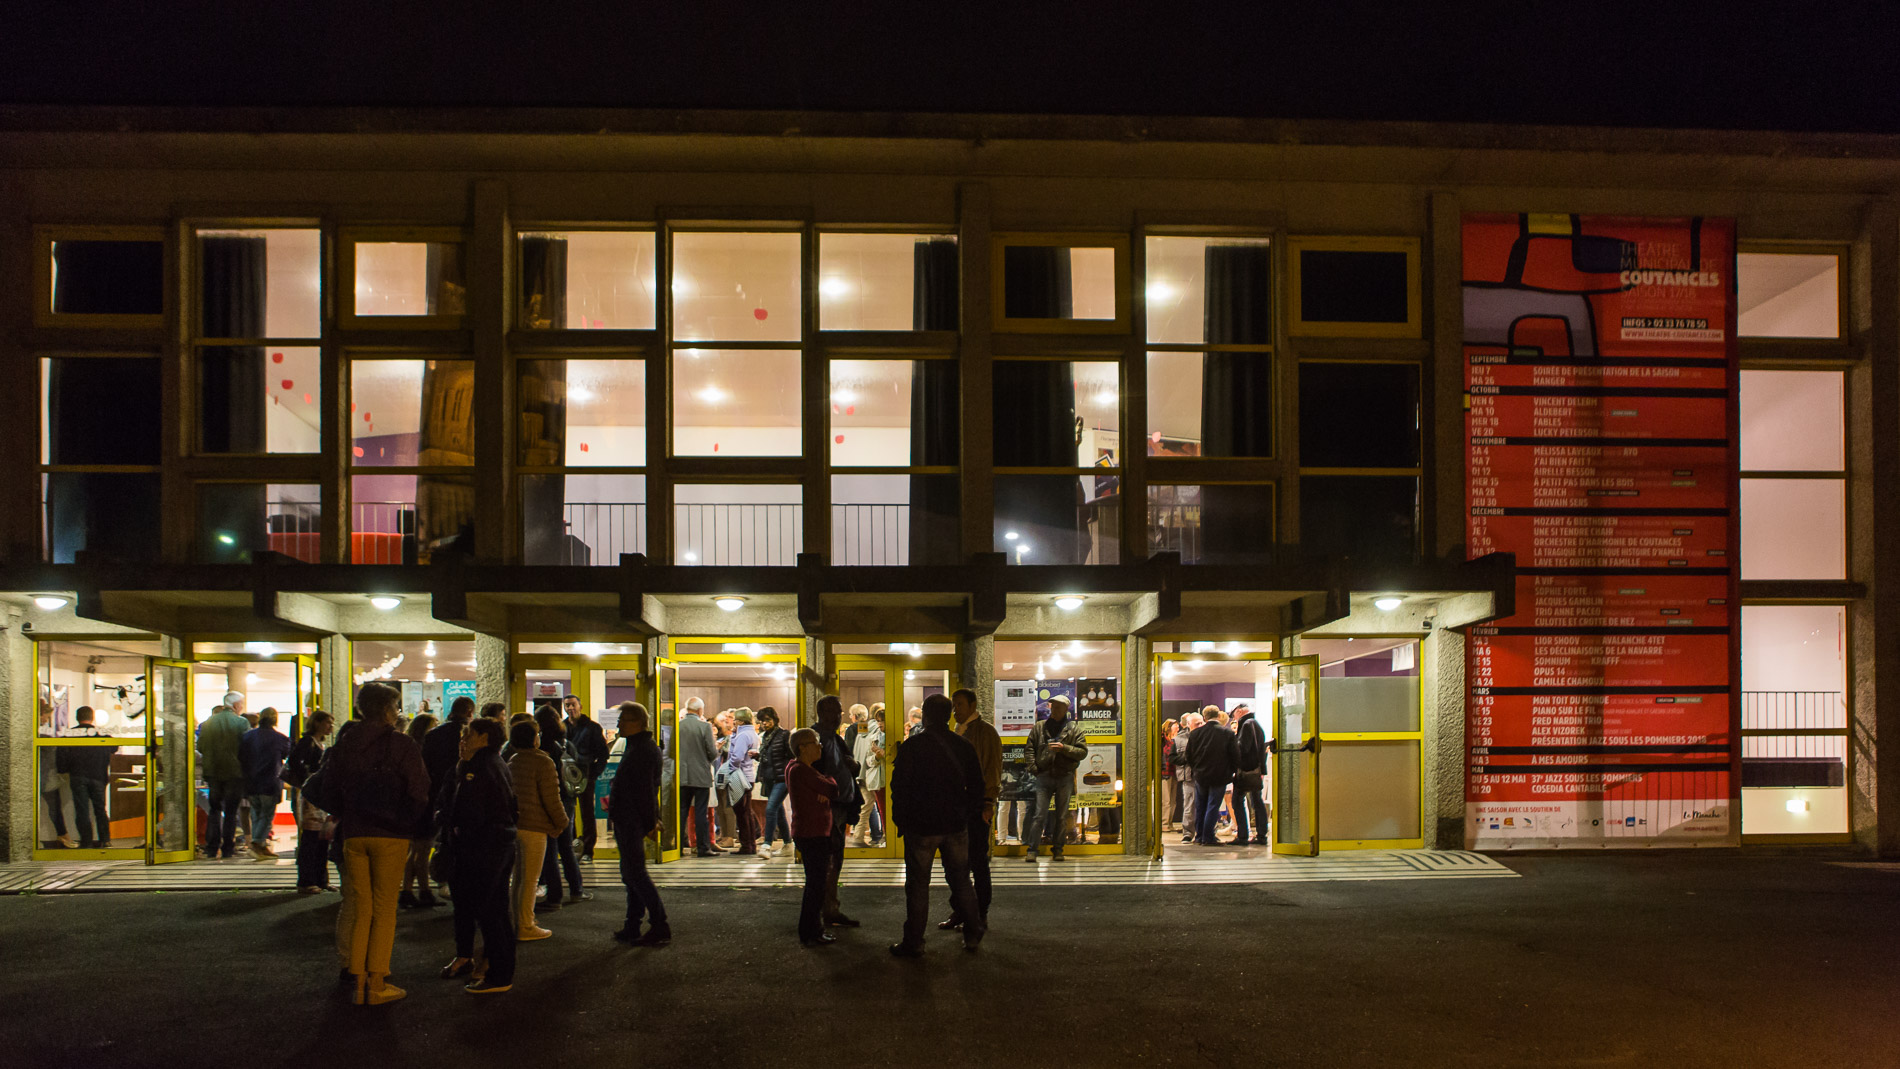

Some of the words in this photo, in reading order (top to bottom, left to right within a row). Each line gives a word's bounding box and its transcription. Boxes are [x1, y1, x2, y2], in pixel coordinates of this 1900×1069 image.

[1619, 269, 1720, 287] COUTANCES
[1623, 318, 1646, 327] INFOS
[1653, 318, 1664, 328] 02
[1665, 319, 1675, 328] 33
[1675, 319, 1685, 328] 76
[1470, 355, 1508, 364] SEPTEMBRE
[1471, 367, 1485, 376] JEU
[1561, 367, 1571, 377] DE
[1629, 368, 1639, 377] DE
[1640, 368, 1651, 377] LA
[1652, 368, 1680, 377] SAISON
[1471, 376, 1483, 385] MA
[1484, 376, 1495, 385] 26
[1533, 377, 1566, 386] MANGER
[1471, 386, 1501, 394] OCTOBRE
[1471, 397, 1487, 406] VEN
[1533, 397, 1566, 406] VINCENT
[1471, 407, 1484, 416] MA
[1485, 407, 1495, 416] 10
[1533, 407, 1572, 416] ALDEBERT
[1471, 417, 1488, 426] MER
[1489, 417, 1499, 426] 18
[1533, 417, 1562, 426] FABLES
[1471, 428, 1482, 436] VE
[1483, 428, 1494, 436] 20
[1533, 428, 1558, 437] LUCKY
[1559, 428, 1599, 437] PETERSON
[1471, 437, 1507, 445] NOVEMBRE
[1471, 447, 1482, 455] SA
[1567, 447, 1602, 456] LAVEAUX
[1623, 447, 1639, 457] AYO
[1471, 457, 1484, 465] MA
[1549, 457, 1567, 466] BIEN
[1568, 457, 1585, 466] FAIT
[1481, 467, 1491, 476] 12
[1533, 467, 1564, 476] AIRELLE
[1471, 478, 1489, 486] MER
[1489, 478, 1499, 486] 15
[1540, 478, 1562, 487] PETIT
[1563, 478, 1578, 487] PAS
[1601, 478, 1615, 487] LES
[1616, 478, 1634, 487] BOIS
[1471, 488, 1484, 496] MA
[1485, 488, 1495, 496] 28
[1533, 488, 1567, 497] SCRATCH
[1471, 498, 1486, 507] JEU
[1486, 498, 1497, 507] 30
[1533, 517, 1565, 526] MOZART
[1573, 517, 1619, 526] BEETHOVEN
[1559, 527, 1589, 536] TENDRE
[1590, 527, 1614, 536] CHAIR
[1481, 537, 1492, 547] 10
[1533, 537, 1577, 546] ORCHESTRE
[1627, 537, 1638, 546] DE
[1639, 537, 1682, 546] COUTANCES
[1534, 558, 1553, 567] LAVE
[1554, 558, 1568, 567] TES
[1569, 558, 1596, 567] ORTIES
[1609, 558, 1641, 567] FAMILLE
[1534, 587, 1562, 596] SOPHIE
[1534, 597, 1568, 606] JACQUES
[1534, 607, 1553, 616] TRIO
[1554, 607, 1575, 616] ANNE
[1578, 617, 1607, 626] CROTTE
[1608, 617, 1619, 626] DE
[1620, 617, 1636, 626] NEZ
[1472, 637, 1483, 645] SA
[1534, 636, 1553, 645] LIOR
[1602, 636, 1646, 645] AVALANCHE
[1647, 636, 1666, 645] 4TET
[1534, 646, 1548, 655] LES
[1549, 645, 1604, 655] DÉCLINAISONS
[1605, 646, 1615, 655] DE
[1616, 646, 1627, 655] LA
[1628, 646, 1664, 655] NAVARRE
[1482, 657, 1491, 666] 15
[1534, 657, 1571, 666] SOMNIUM
[1481, 667, 1492, 676] 22
[1533, 667, 1555, 676] OPUS
[1556, 667, 1566, 676] 14
[1471, 677, 1482, 686] SA
[1483, 677, 1494, 686] 24
[1533, 677, 1565, 686] CAMILLE
[1566, 677, 1605, 686] CHAMOUX
[1472, 687, 1490, 695] MARS
[1532, 696, 1551, 705] MON
[1551, 696, 1568, 705] TOIT
[1569, 696, 1581, 705] DU
[1581, 696, 1610, 705] MONDE
[1082, 710, 1111, 719] MANGER
[1481, 706, 1491, 715] 15
[1531, 706, 1557, 715] PIANO
[1557, 706, 1573, 715] SUR
[1584, 706, 1597, 715] FIL
[1482, 717, 1493, 726] 23
[1531, 716, 1552, 725] FRED
[1552, 716, 1583, 725] NARDIN
[1584, 716, 1603, 725] TRIO
[1481, 727, 1491, 736] 25
[1531, 726, 1551, 736] ALEX
[1552, 726, 1586, 736] VIZOREK
[1482, 737, 1493, 746] 30
[1531, 735, 1588, 746] PRÉSENTATION
[1589, 736, 1607, 745] JAZZ
[1608, 736, 1629, 745] SOUS
[1630, 736, 1644, 745] LES
[1645, 736, 1686, 745] POMMIERS
[1687, 735, 1708, 745] 2018
[1471, 747, 1489, 755] AVRIL
[1471, 756, 1484, 765] MA
[1538, 755, 1554, 765] MES
[1555, 755, 1589, 765] AMOURS
[1471, 774, 1482, 784] DU
[1490, 774, 1500, 784] AU
[1545, 774, 1563, 783] JAZZ
[1564, 774, 1585, 783] SOUS
[1586, 774, 1600, 783] LES
[1601, 773, 1643, 783] POMMIERS
[1480, 785, 1492, 794] 20
[1531, 784, 1564, 794] COSEDIA
[1565, 784, 1607, 794] CANTABILE
